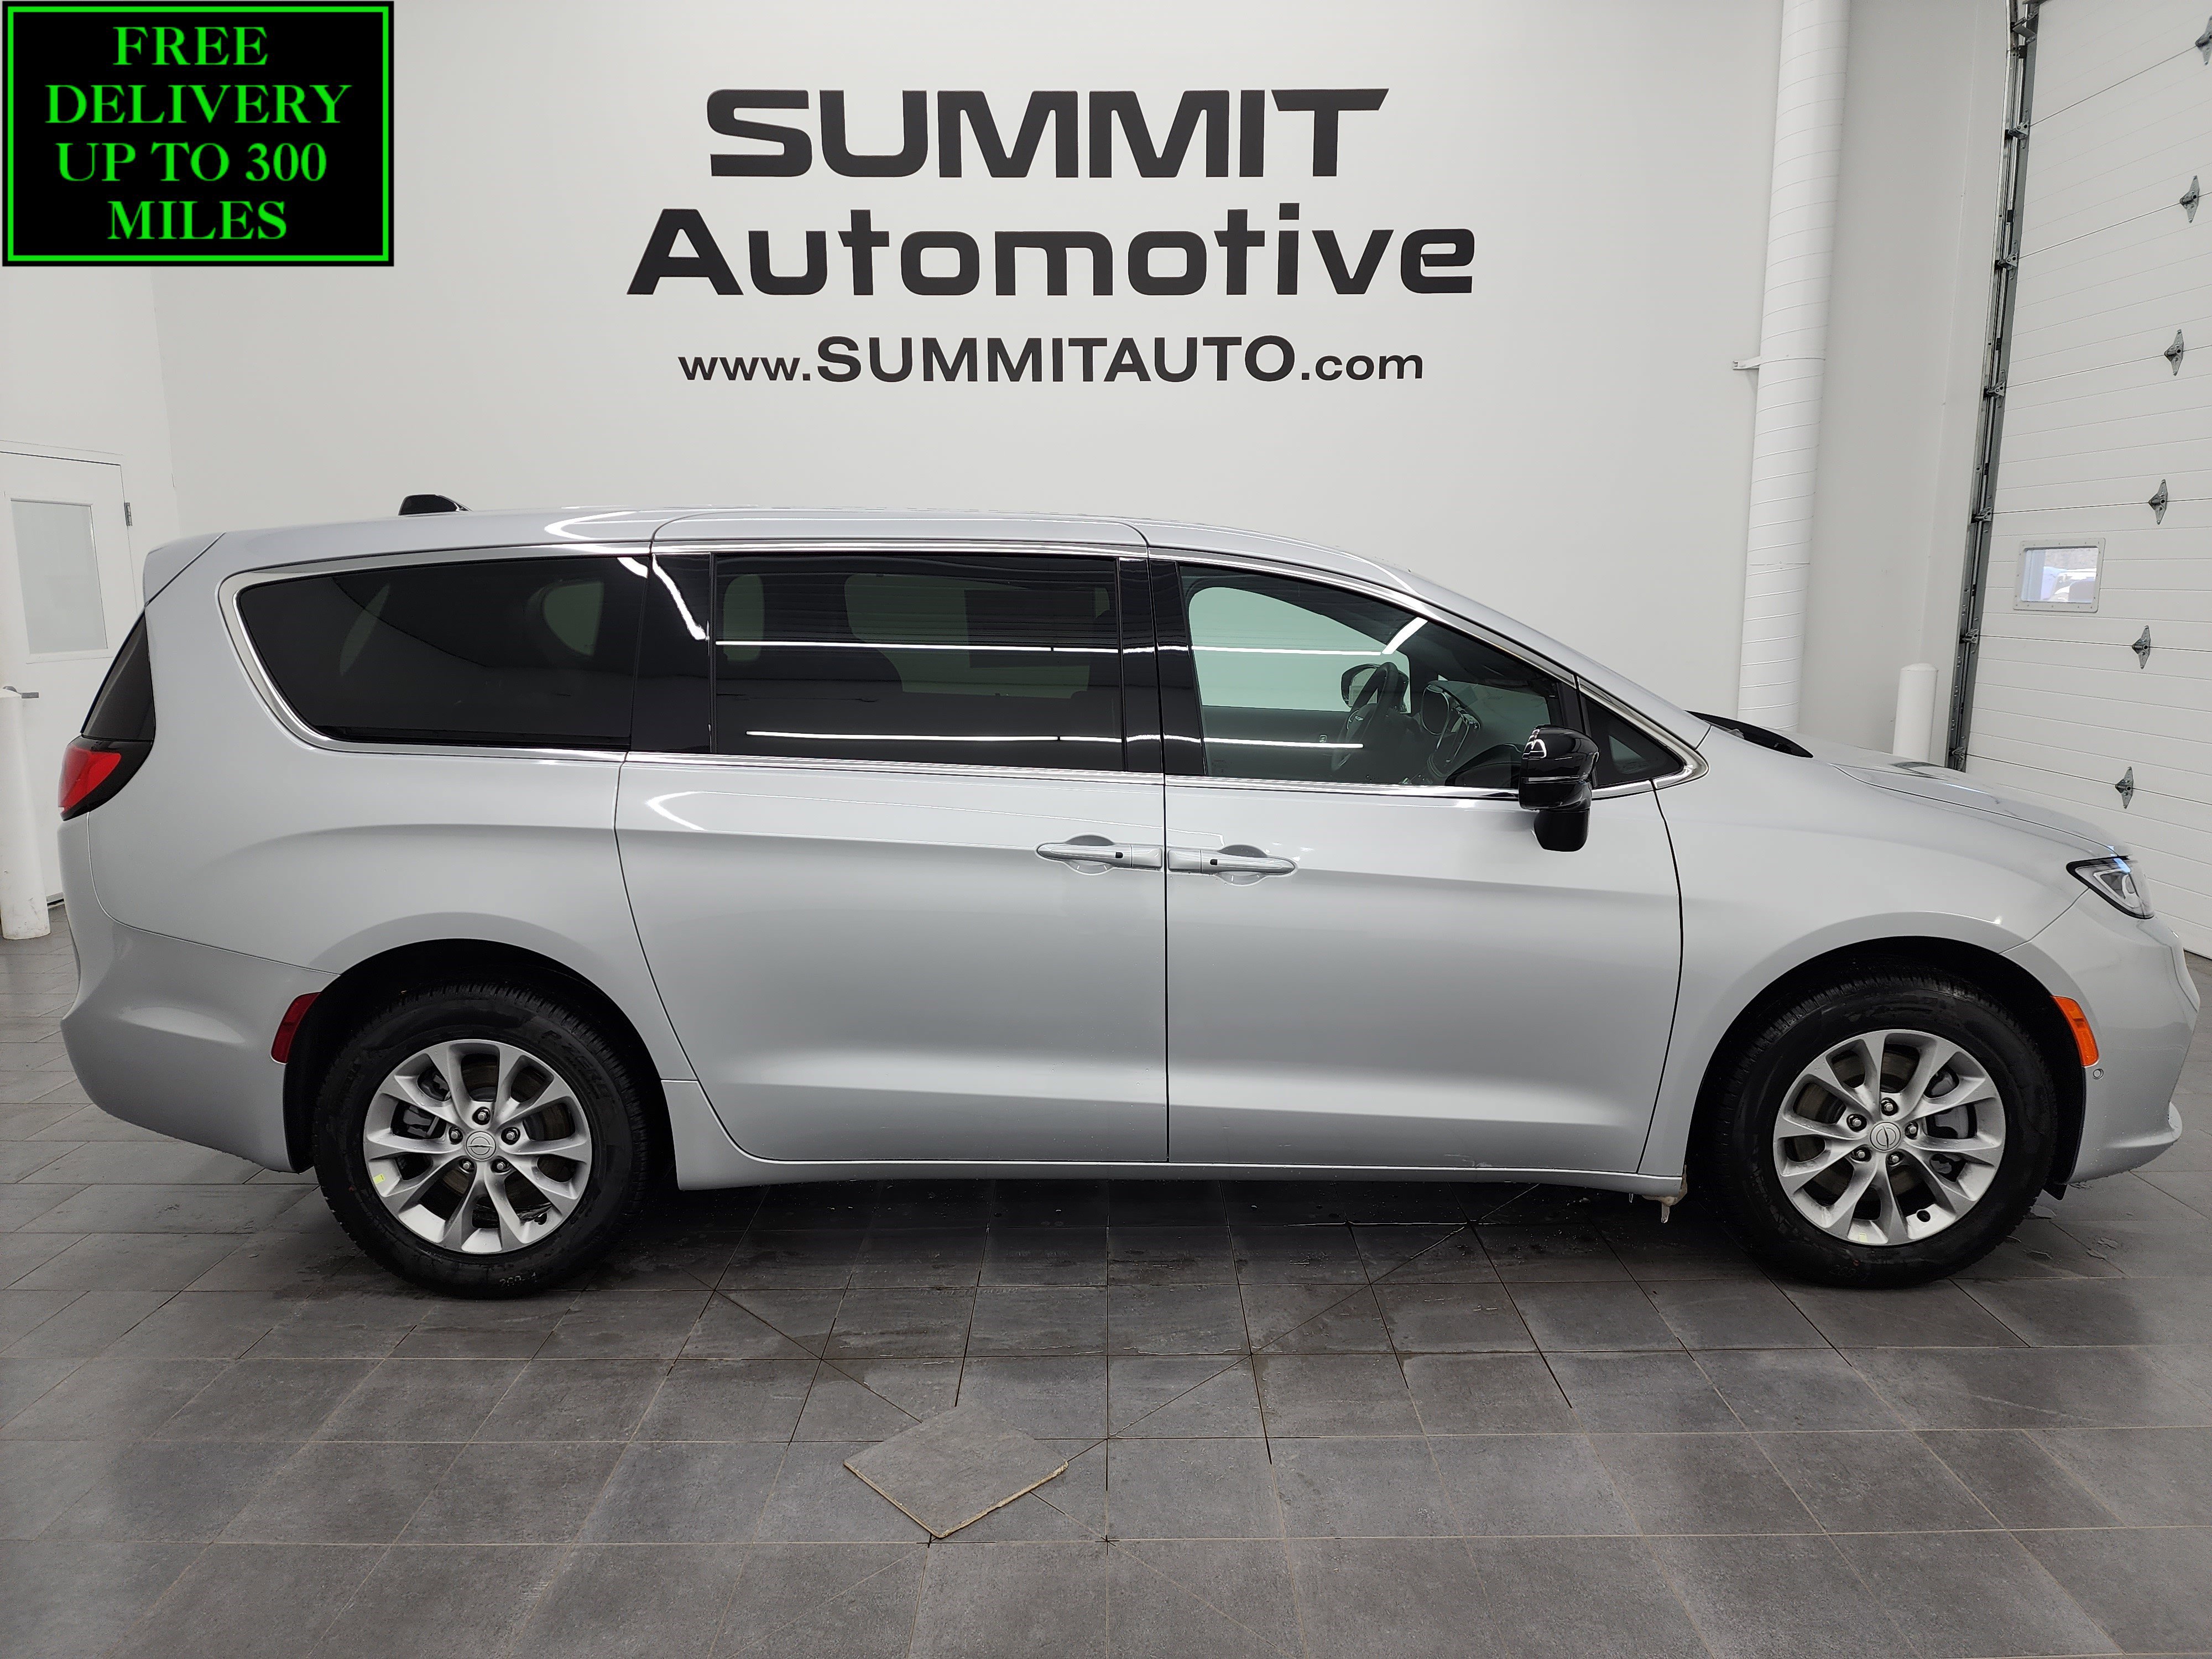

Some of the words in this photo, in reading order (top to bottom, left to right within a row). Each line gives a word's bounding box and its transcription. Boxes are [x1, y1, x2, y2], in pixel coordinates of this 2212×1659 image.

[707, 89, 1389, 178] SUMMIT
[627, 203, 1474, 295] Automotive
[678, 336, 1422, 382] www.SUMMITAUTO.com
